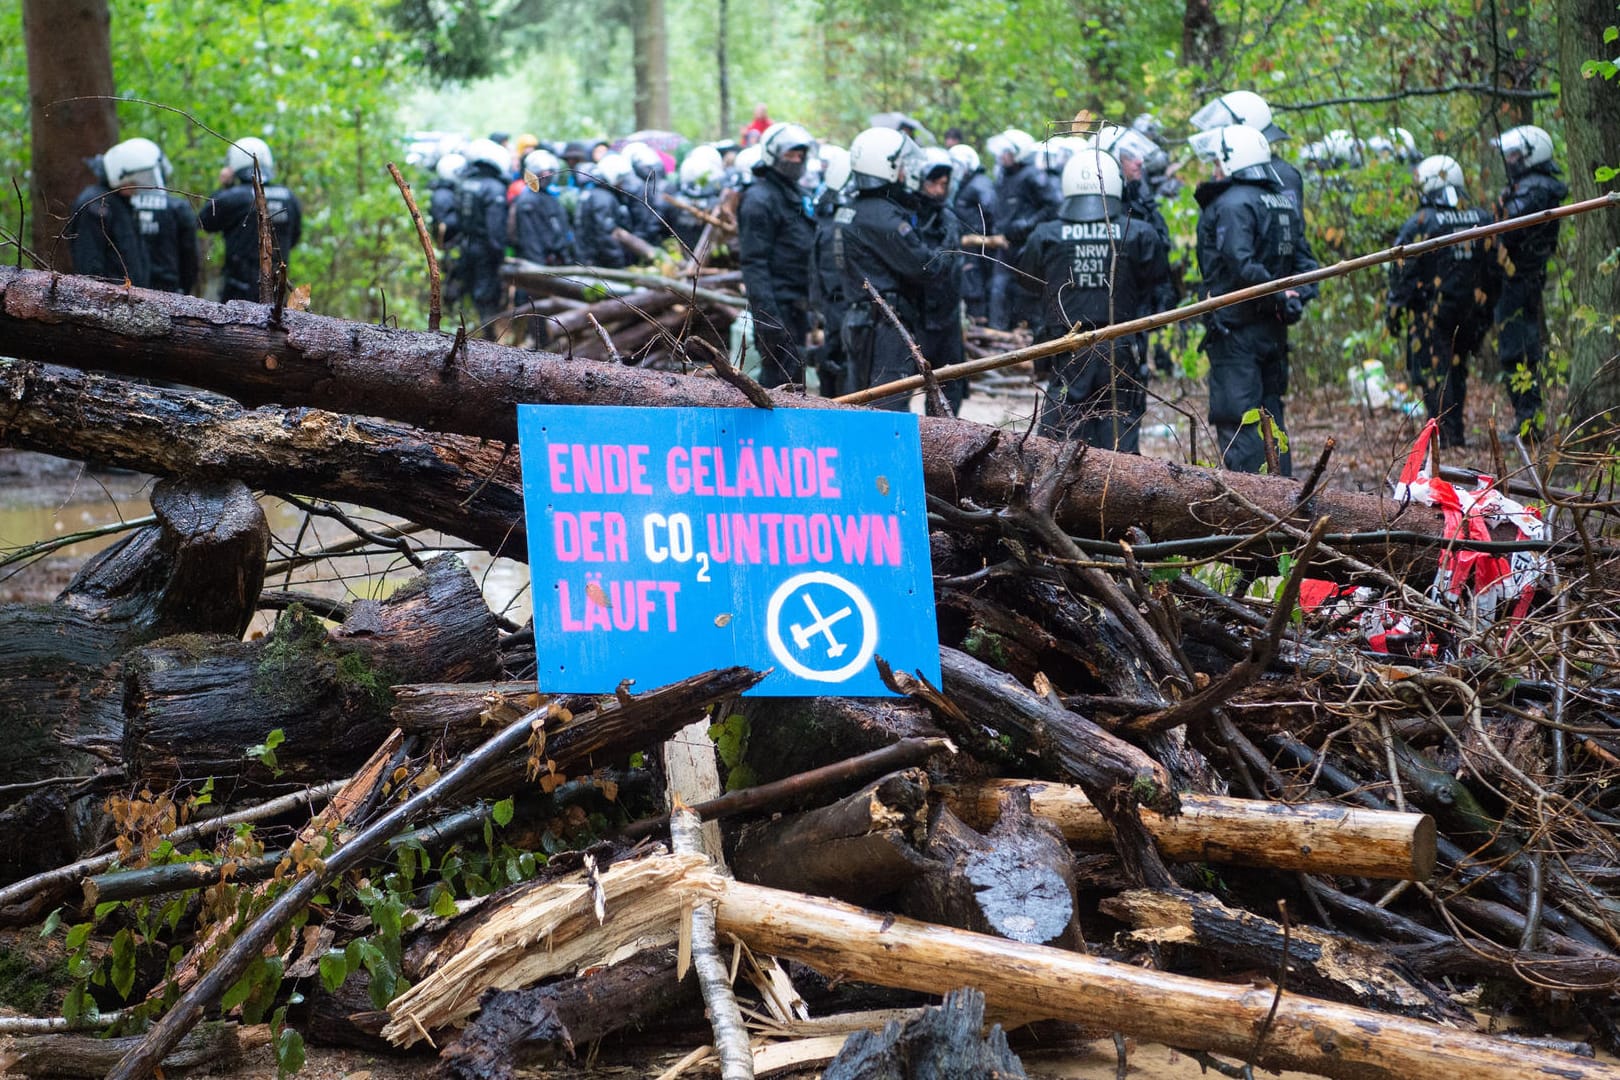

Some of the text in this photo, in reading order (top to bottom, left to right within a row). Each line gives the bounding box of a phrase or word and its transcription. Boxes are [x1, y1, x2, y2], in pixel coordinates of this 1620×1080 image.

[1061, 222, 1121, 240] POLIZEI
[1075, 244, 1109, 258] NRW
[1073, 259, 1104, 273] 2631
[1079, 273, 1106, 288] FLT
[547, 439, 842, 499] ENDE GELÄNDE
[552, 511, 629, 563] DER
[558, 572, 681, 633] LÄUFT
